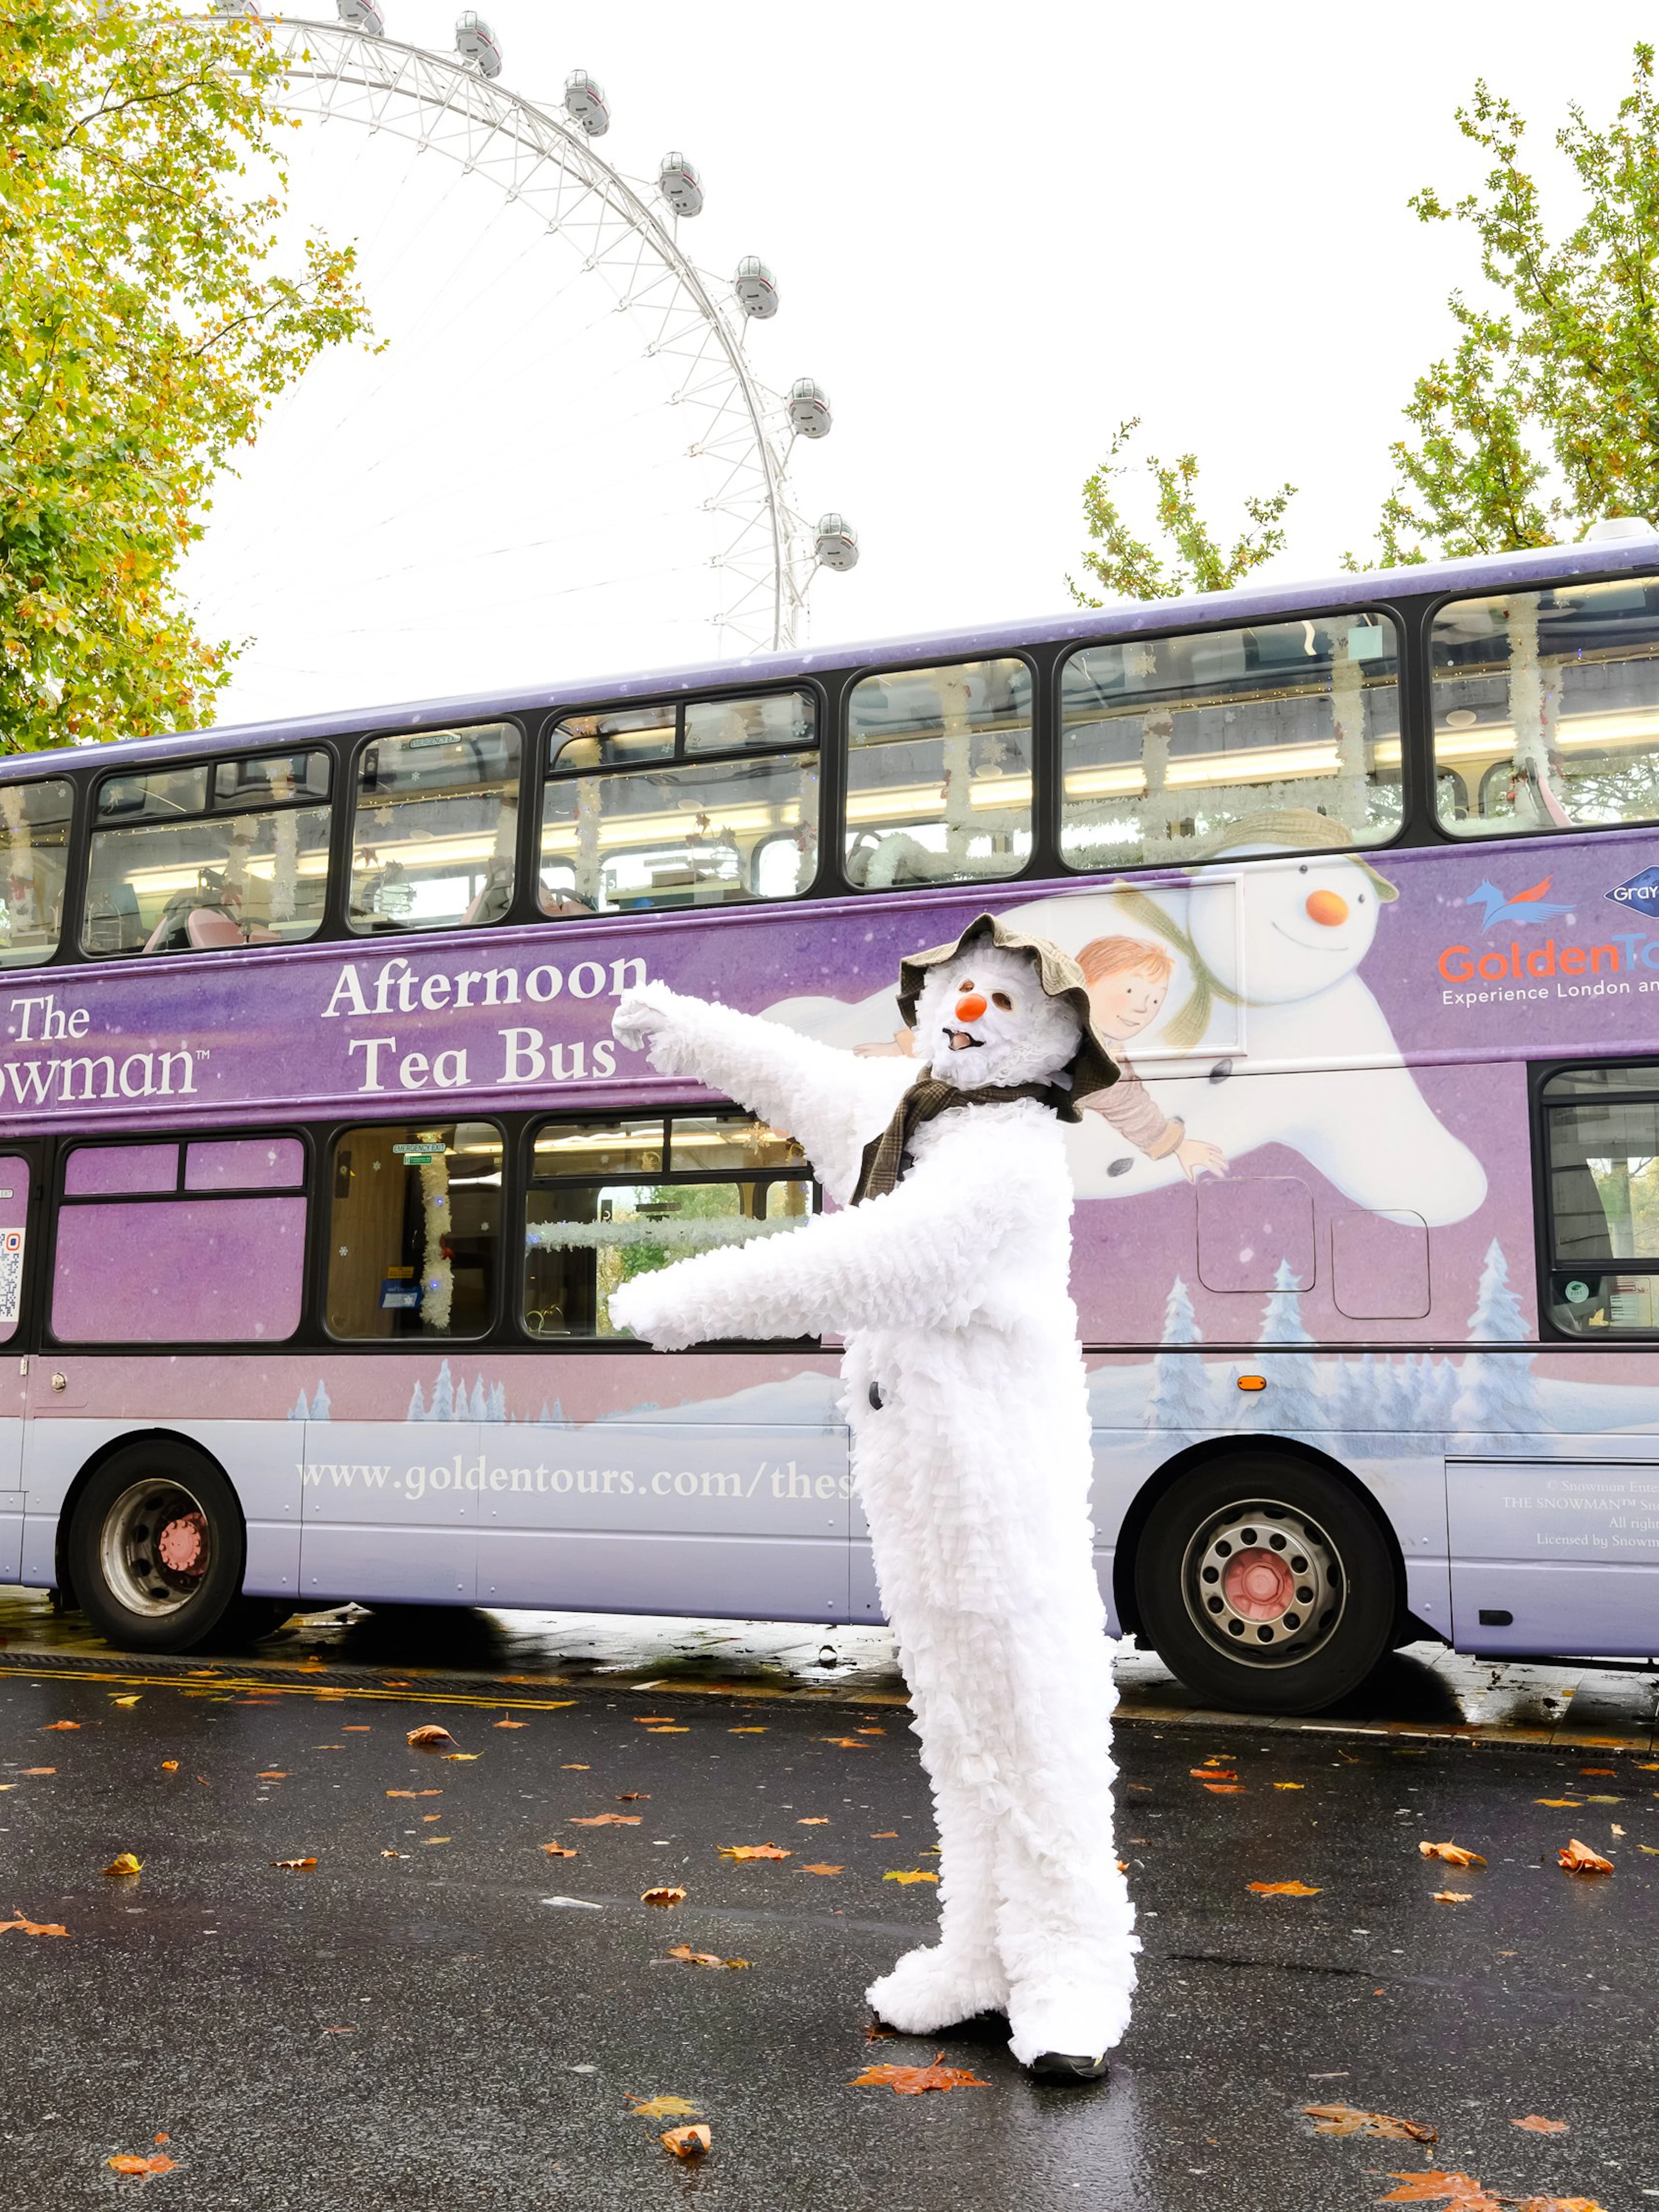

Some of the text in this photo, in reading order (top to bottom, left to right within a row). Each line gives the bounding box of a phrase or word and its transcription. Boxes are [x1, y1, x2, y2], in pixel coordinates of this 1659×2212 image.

[321, 958, 647, 1017] Afternoon
[1442, 987, 1549, 1008] Experience
[1557, 979, 1630, 998] London
[10, 994, 90, 1042] The
[349, 1027, 617, 1091] Tea Bus
[295, 1454, 862, 1500] www.goldentours.com/thes
[1561, 1481, 1624, 1492] Snowman
[1629, 1481, 1659, 1493] Ente
[1503, 1497, 1532, 1509] THE
[1608, 1517, 1626, 1529] All
[1537, 1533, 1589, 1545] Licensed
[1592, 1534, 1608, 1549] by
